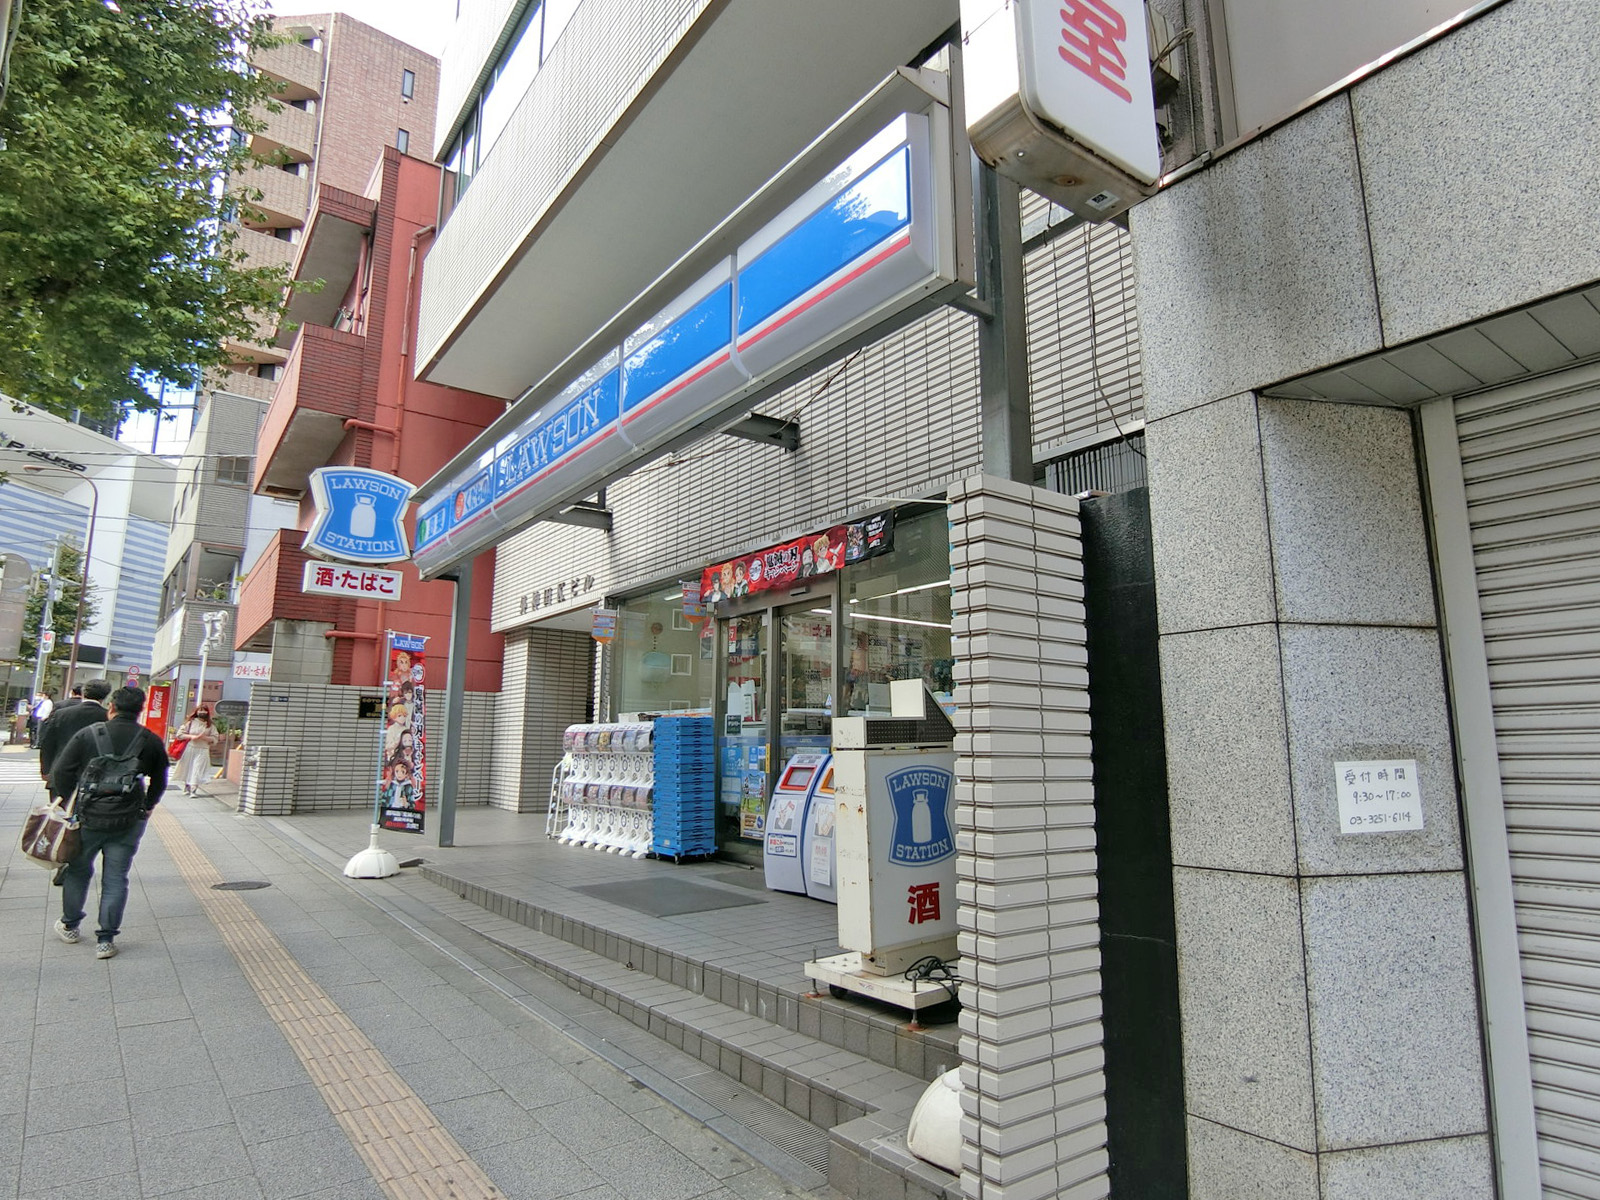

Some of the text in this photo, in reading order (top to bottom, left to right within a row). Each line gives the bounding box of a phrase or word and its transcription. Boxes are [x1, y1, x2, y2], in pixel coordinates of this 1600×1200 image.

[504, 387, 603, 486] LAWSON
[331, 478, 402, 500] LAWSON
[325, 531, 396, 552] STATION
[315, 566, 395, 593] 酒・たばこ
[764, 562, 800, 580] キャンペーン
[394, 639, 425, 650] LAWSON
[892, 773, 947, 792] LAWSON
[1345, 768, 1405, 785] 受付時間
[896, 838, 949, 860] STATION
[907, 882, 941, 925] 酒
